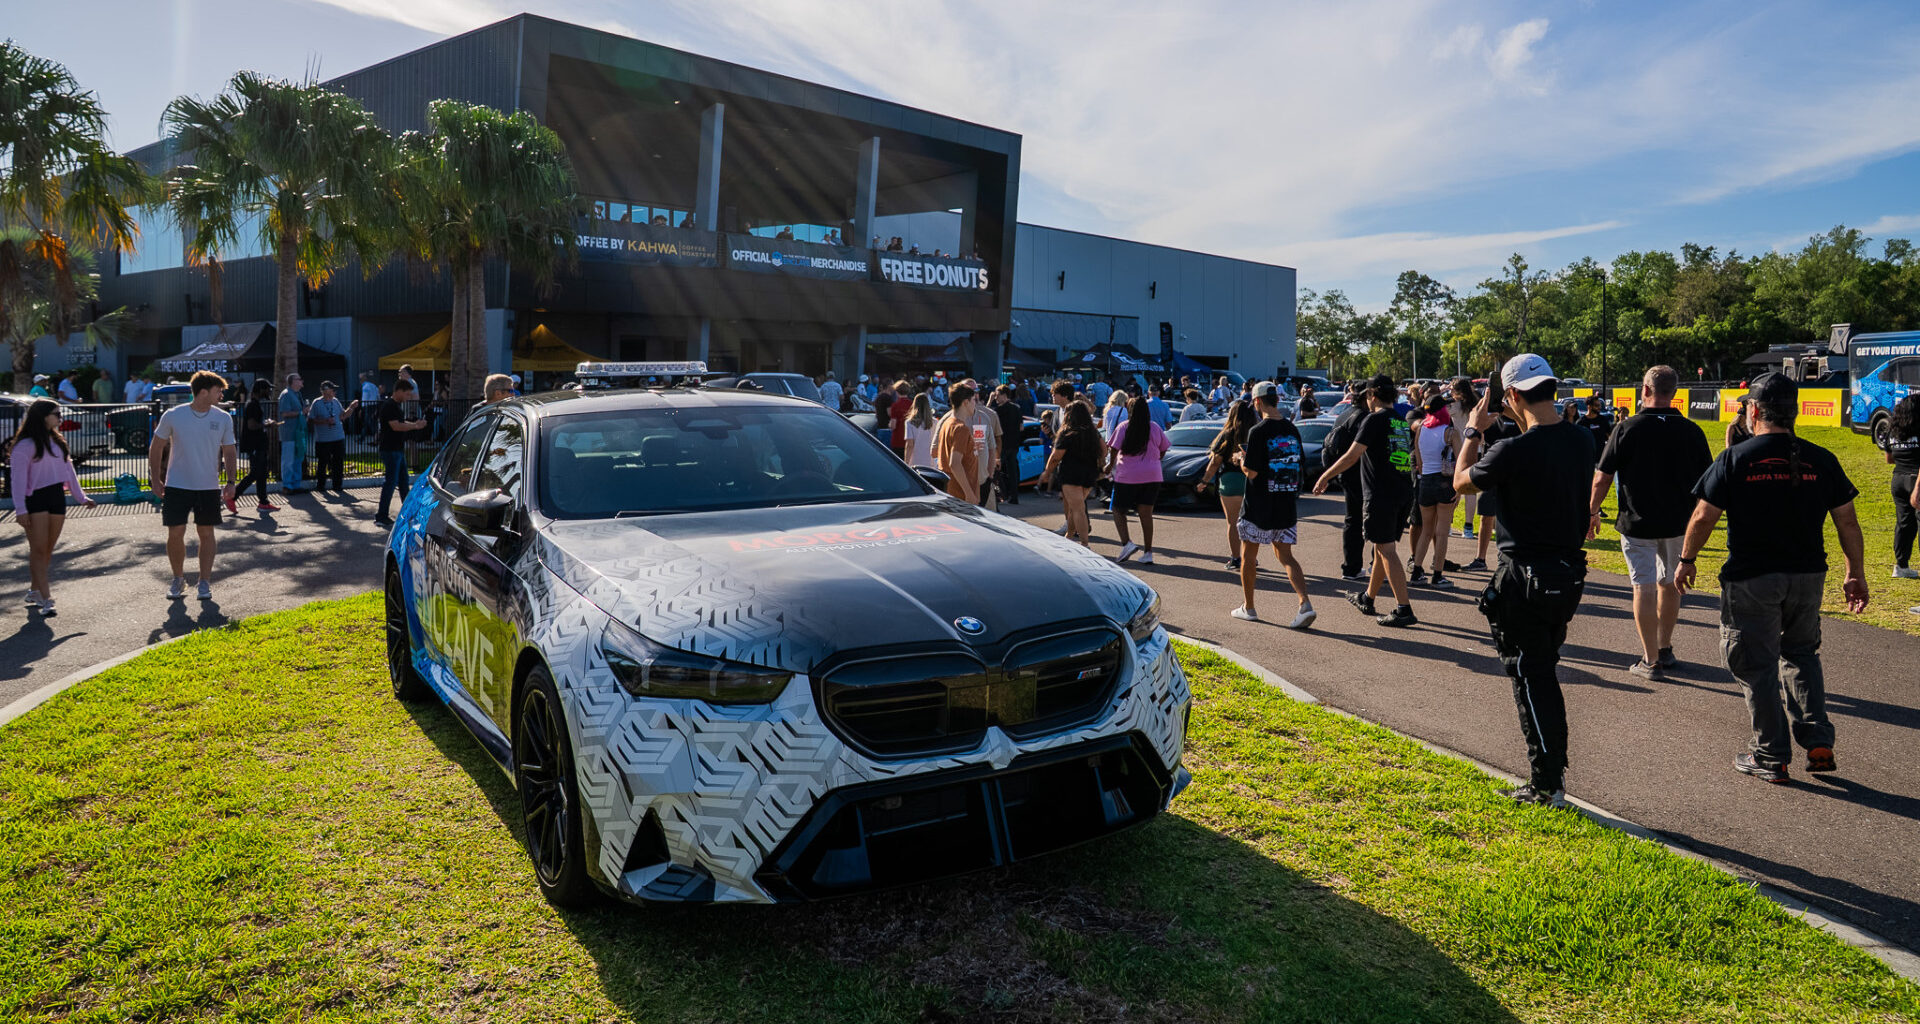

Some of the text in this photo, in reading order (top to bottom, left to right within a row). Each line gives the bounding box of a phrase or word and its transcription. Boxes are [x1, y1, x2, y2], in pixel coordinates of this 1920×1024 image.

[575, 235, 609, 250] OFFEE
[610, 238, 624, 250] BY
[627, 240, 678, 255] KAHWA
[732, 249, 867, 272] OFFICIAL MERCHANDISE
[880, 258, 989, 290] FREE DONUTS
[1856, 347, 1870, 356] GET
[1870, 346, 1890, 356] YOUR
[1891, 345, 1915, 355] EVENT
[161, 360, 227, 372] THE MOTOR ENCLAVE
[1802, 401, 1834, 416] PIRELLI
[728, 523, 965, 552] MORGAN
[786, 536, 938, 553] AUTOMOTIVE GROUP
[426, 533, 440, 572] THE
[411, 557, 495, 716] ENCLAVE
